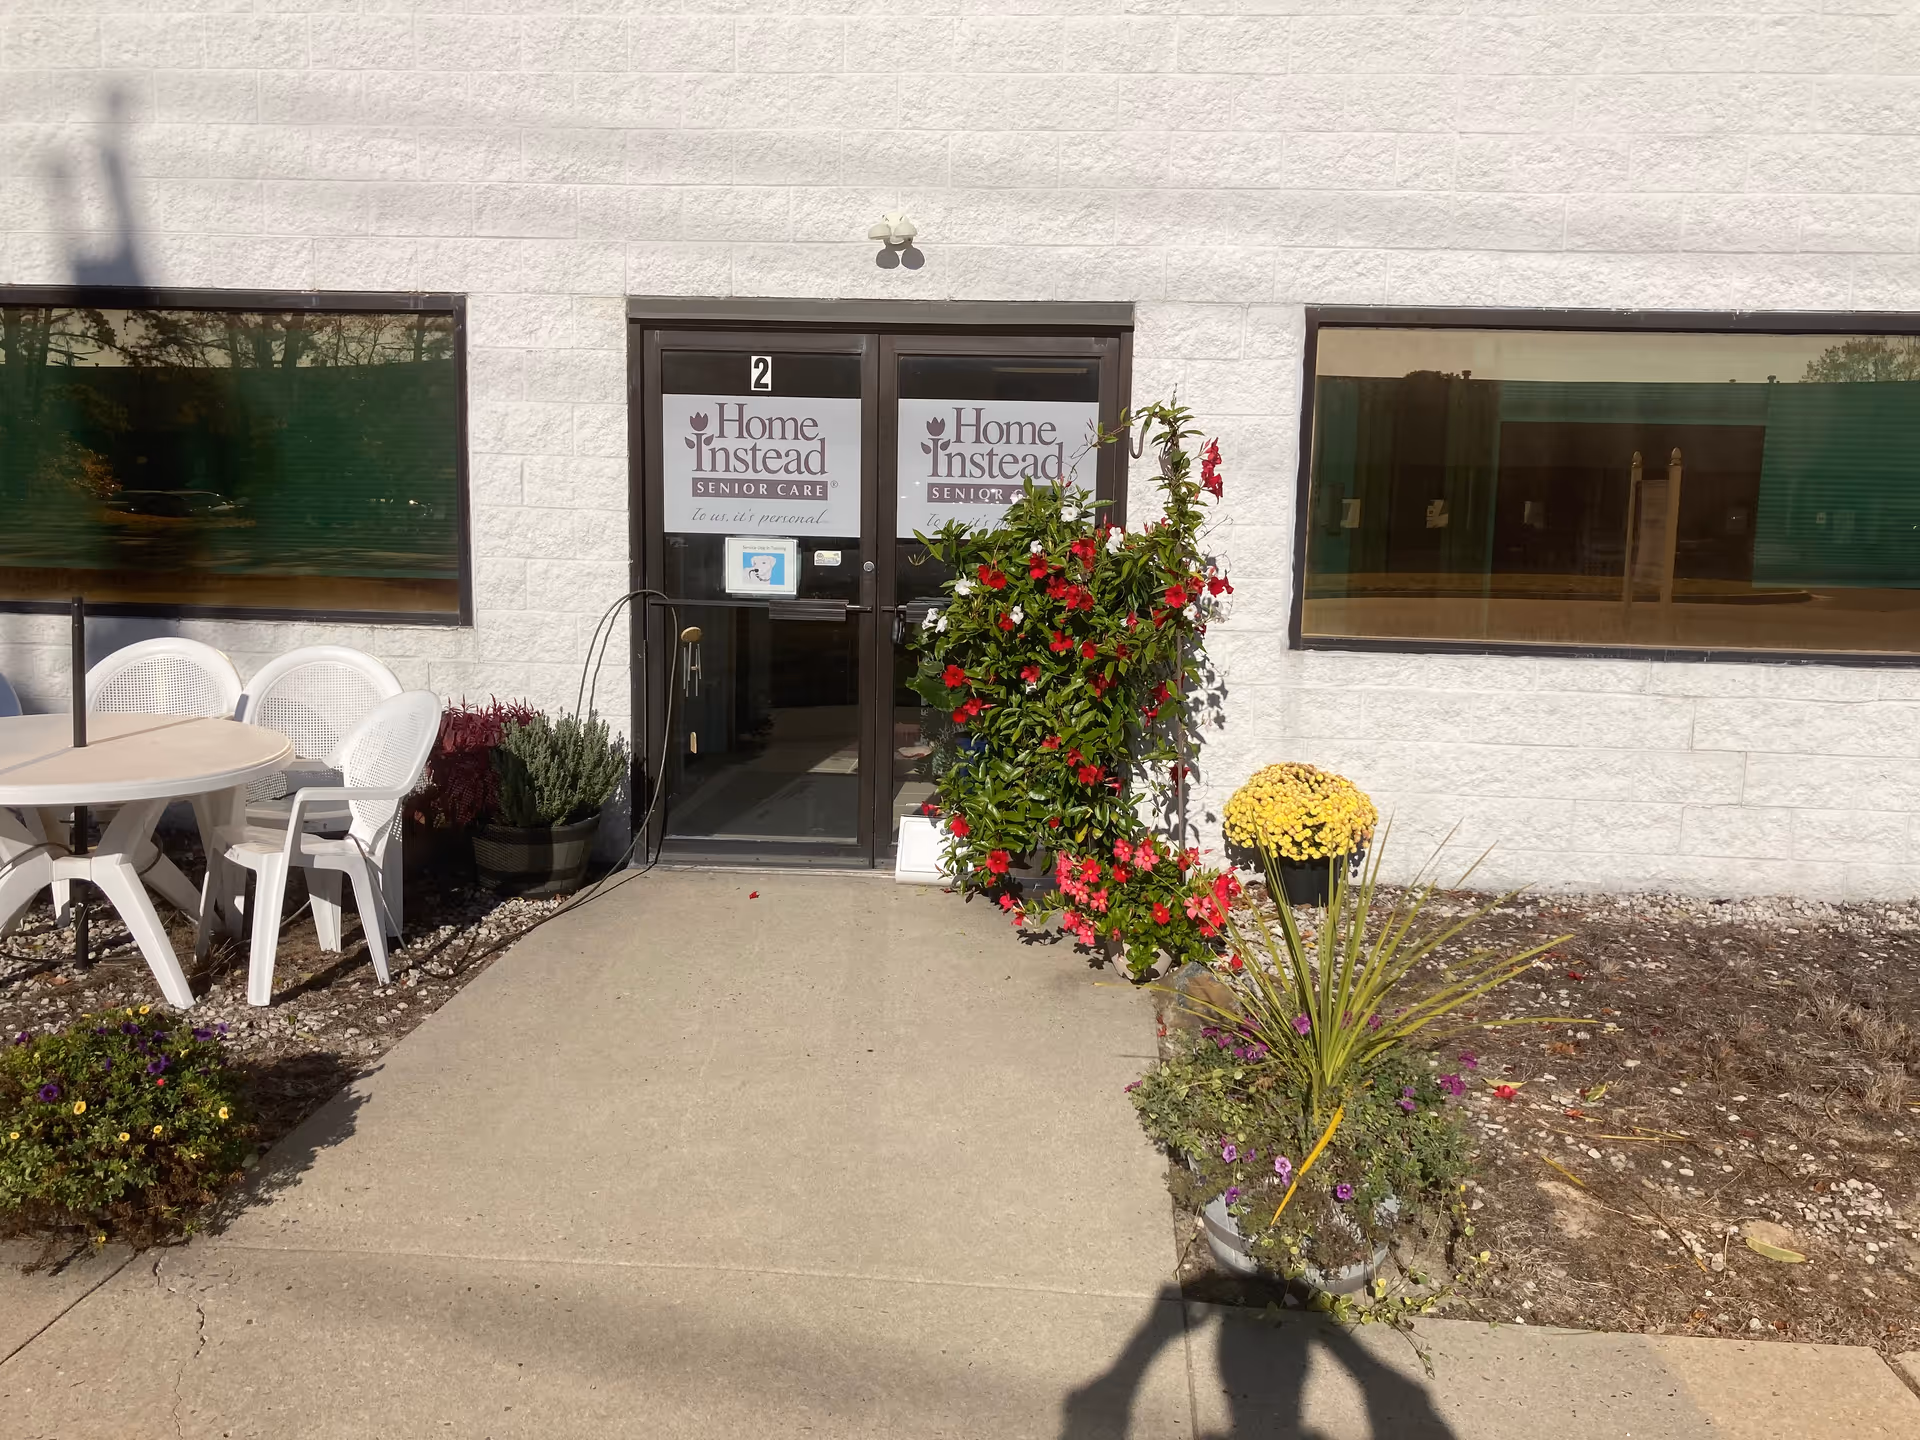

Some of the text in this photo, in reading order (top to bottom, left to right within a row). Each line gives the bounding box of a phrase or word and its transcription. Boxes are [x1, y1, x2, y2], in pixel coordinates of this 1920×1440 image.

[754, 357, 769, 389] 2
[714, 402, 819, 441] Home
[952, 407, 1058, 446] Home
[691, 433, 828, 476] Instead
[927, 438, 1064, 480] Instead
[697, 481, 768, 496] SENIOR
[932, 486, 1003, 500] SENIOR
[691, 507, 707, 521] To
[733, 508, 755, 522] it's
